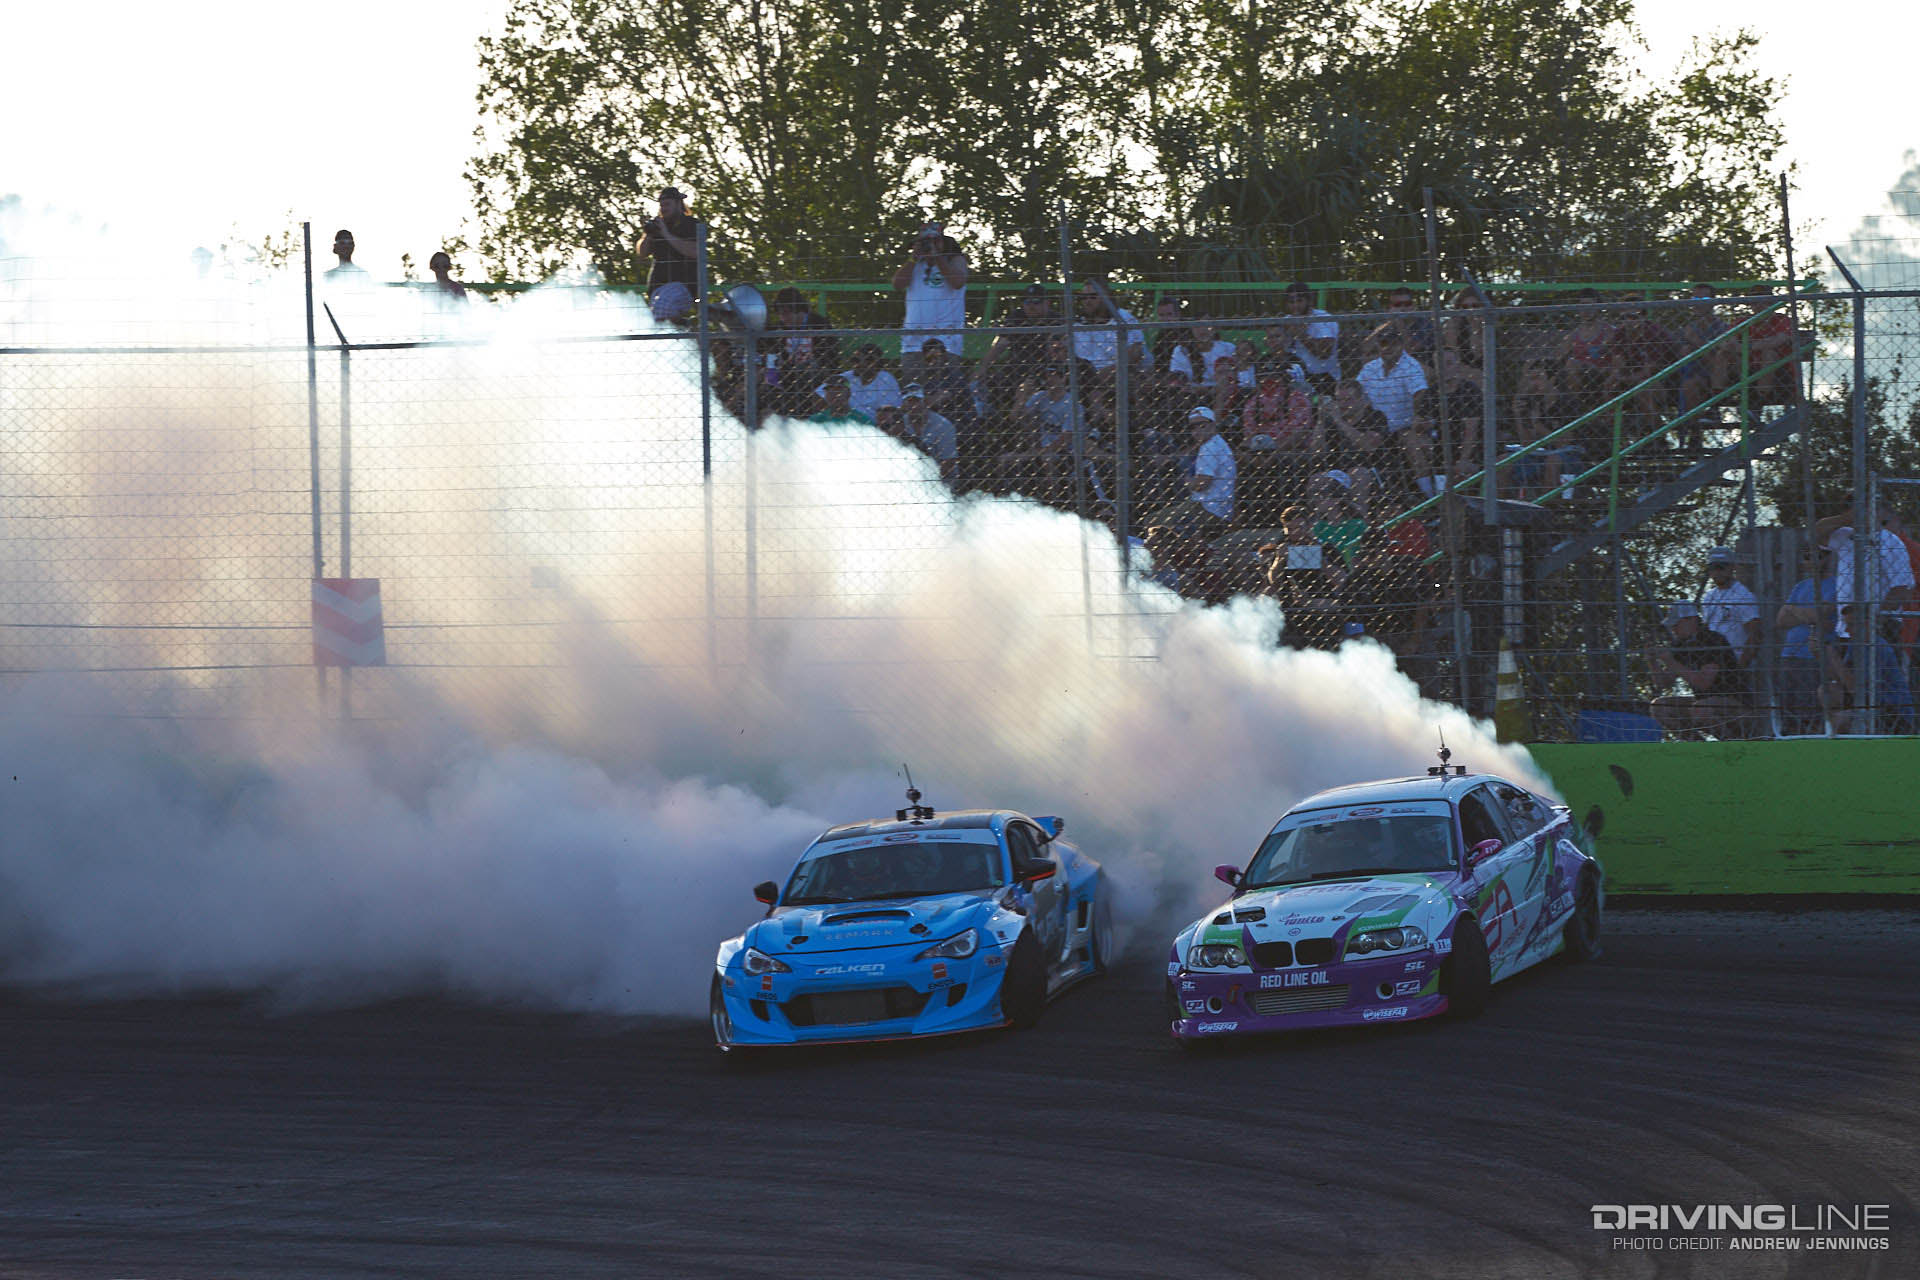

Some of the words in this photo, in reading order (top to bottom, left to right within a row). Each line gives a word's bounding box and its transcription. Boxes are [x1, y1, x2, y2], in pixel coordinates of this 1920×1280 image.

[815, 963, 887, 975] FALKEN
[1260, 976, 1281, 988] RED
[1284, 973, 1309, 987] LINE
[1311, 971, 1329, 985] OIL
